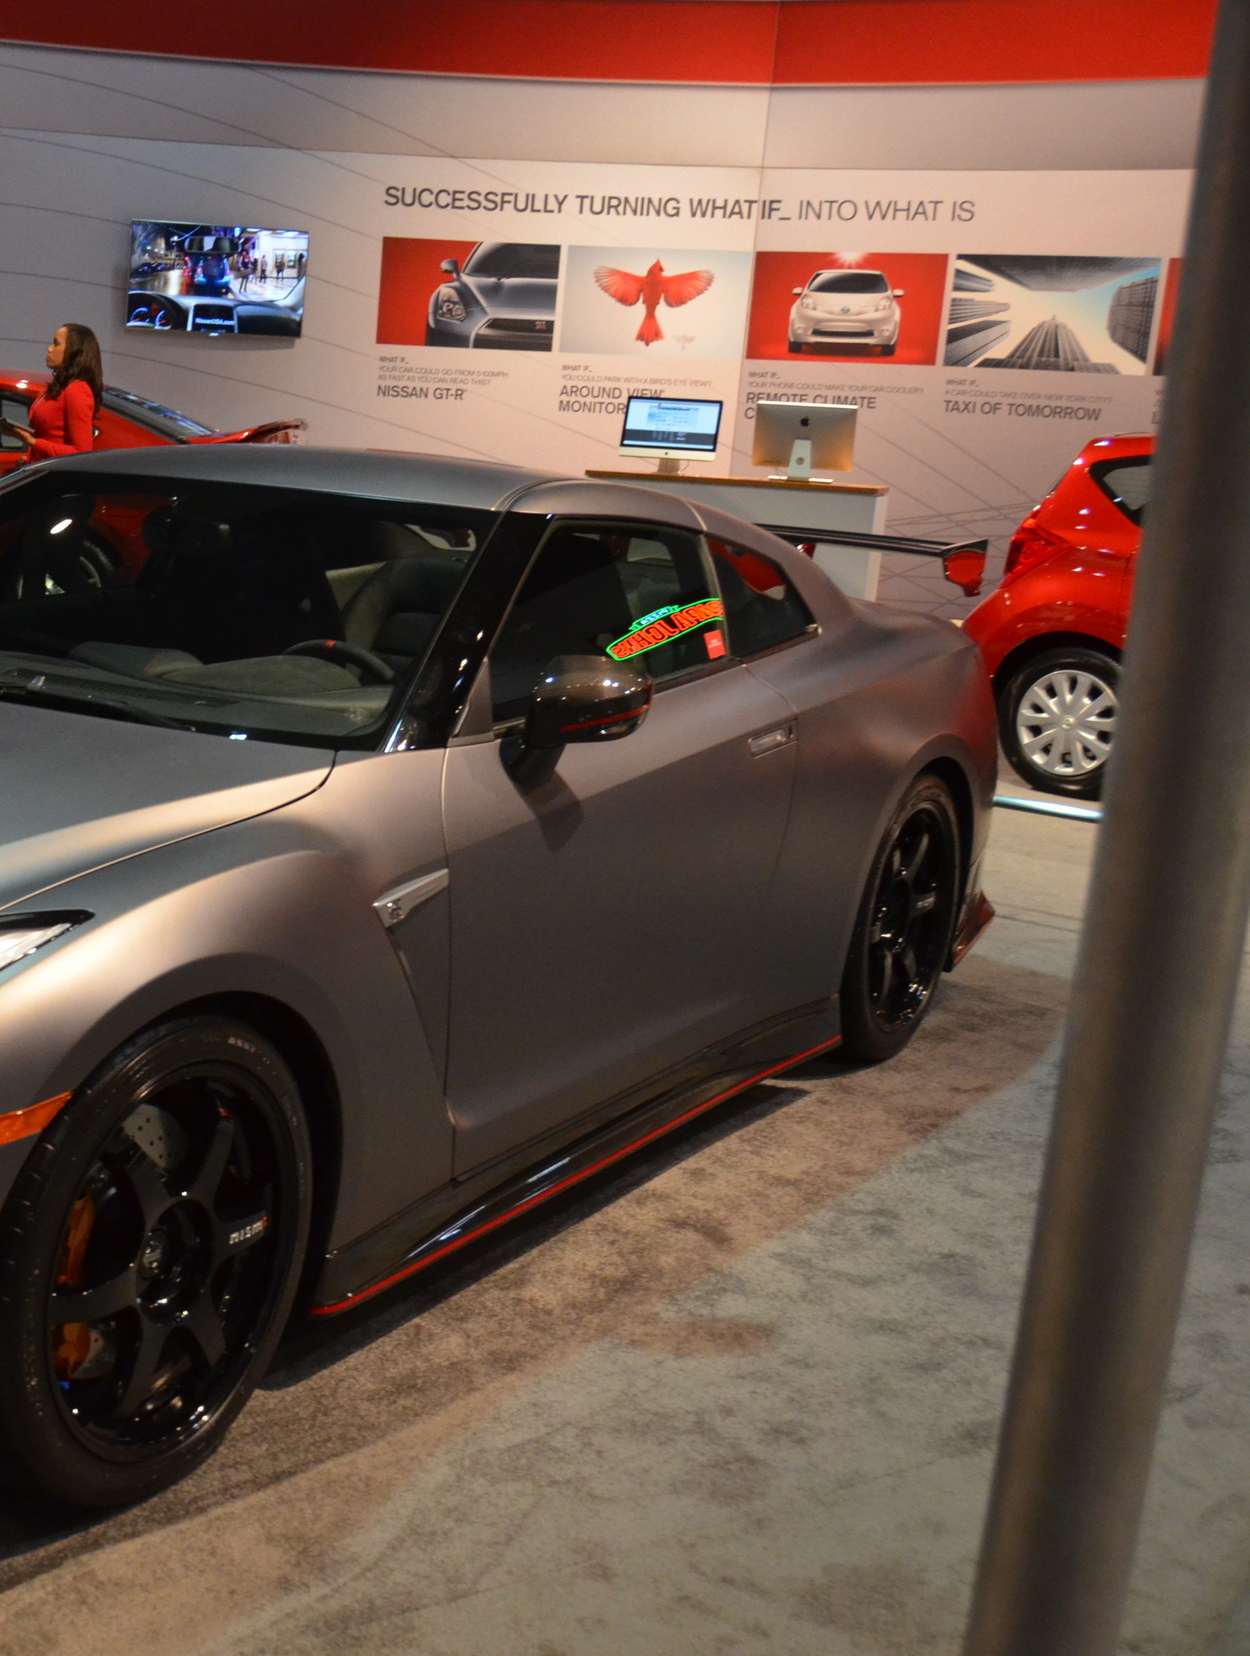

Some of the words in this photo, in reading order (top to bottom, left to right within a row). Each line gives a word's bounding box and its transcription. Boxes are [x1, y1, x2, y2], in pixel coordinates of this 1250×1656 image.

[384, 186, 569, 213] SUCCESSFULLY
[575, 195, 681, 217] TURNING
[689, 198, 758, 221] WHAT
[798, 200, 858, 221] INTO
[864, 200, 944, 222] WHAT
[951, 200, 976, 222] IS
[377, 385, 429, 399] NISSAN
[560, 384, 622, 399] AROUND
[559, 400, 626, 416] MONITOR
[746, 392, 809, 404] REMOTE
[812, 394, 877, 409] CLIMATE
[943, 400, 976, 414] TAXI
[980, 402, 1002, 416] OF
[1007, 403, 1102, 421] TOMORROW
